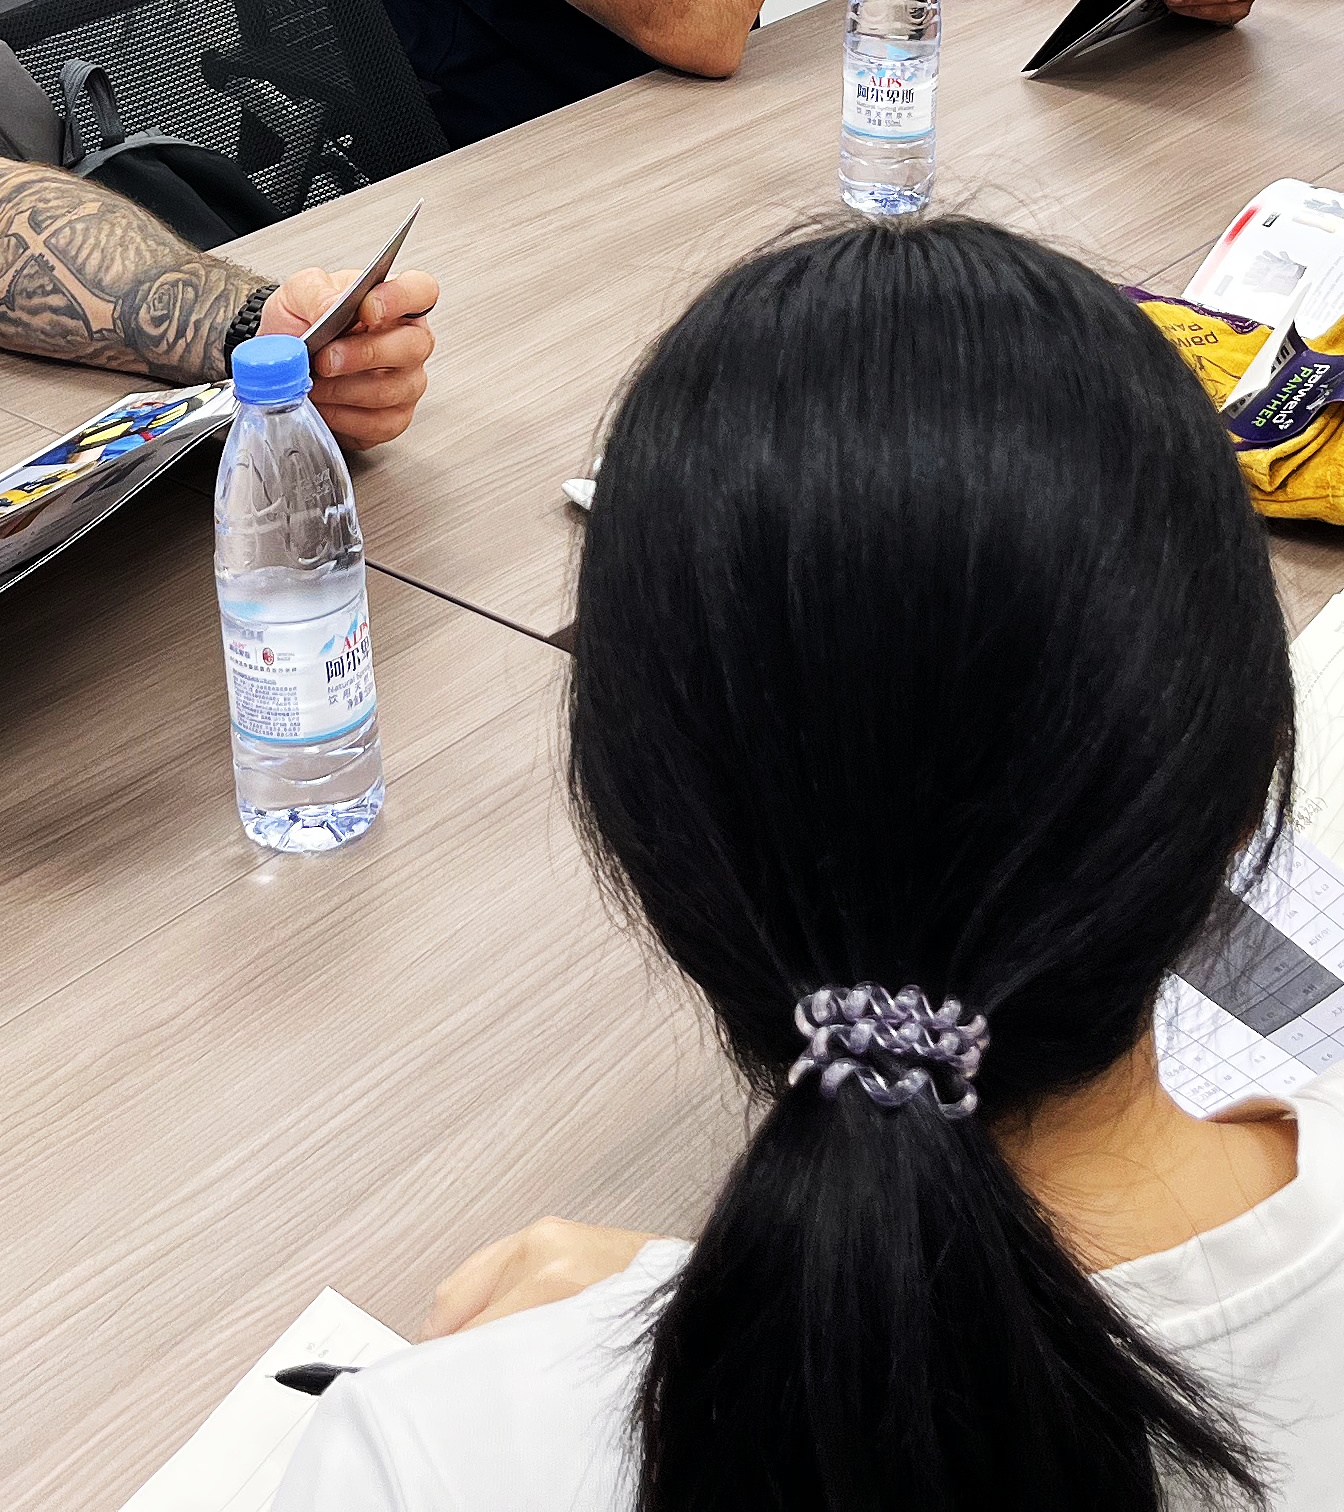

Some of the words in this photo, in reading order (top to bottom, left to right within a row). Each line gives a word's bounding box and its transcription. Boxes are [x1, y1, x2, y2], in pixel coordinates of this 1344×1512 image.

[869, 76, 902, 88] ALPS
[857, 83, 915, 104] 阿尔卑斯
[1251, 366, 1313, 427] PANTHER
